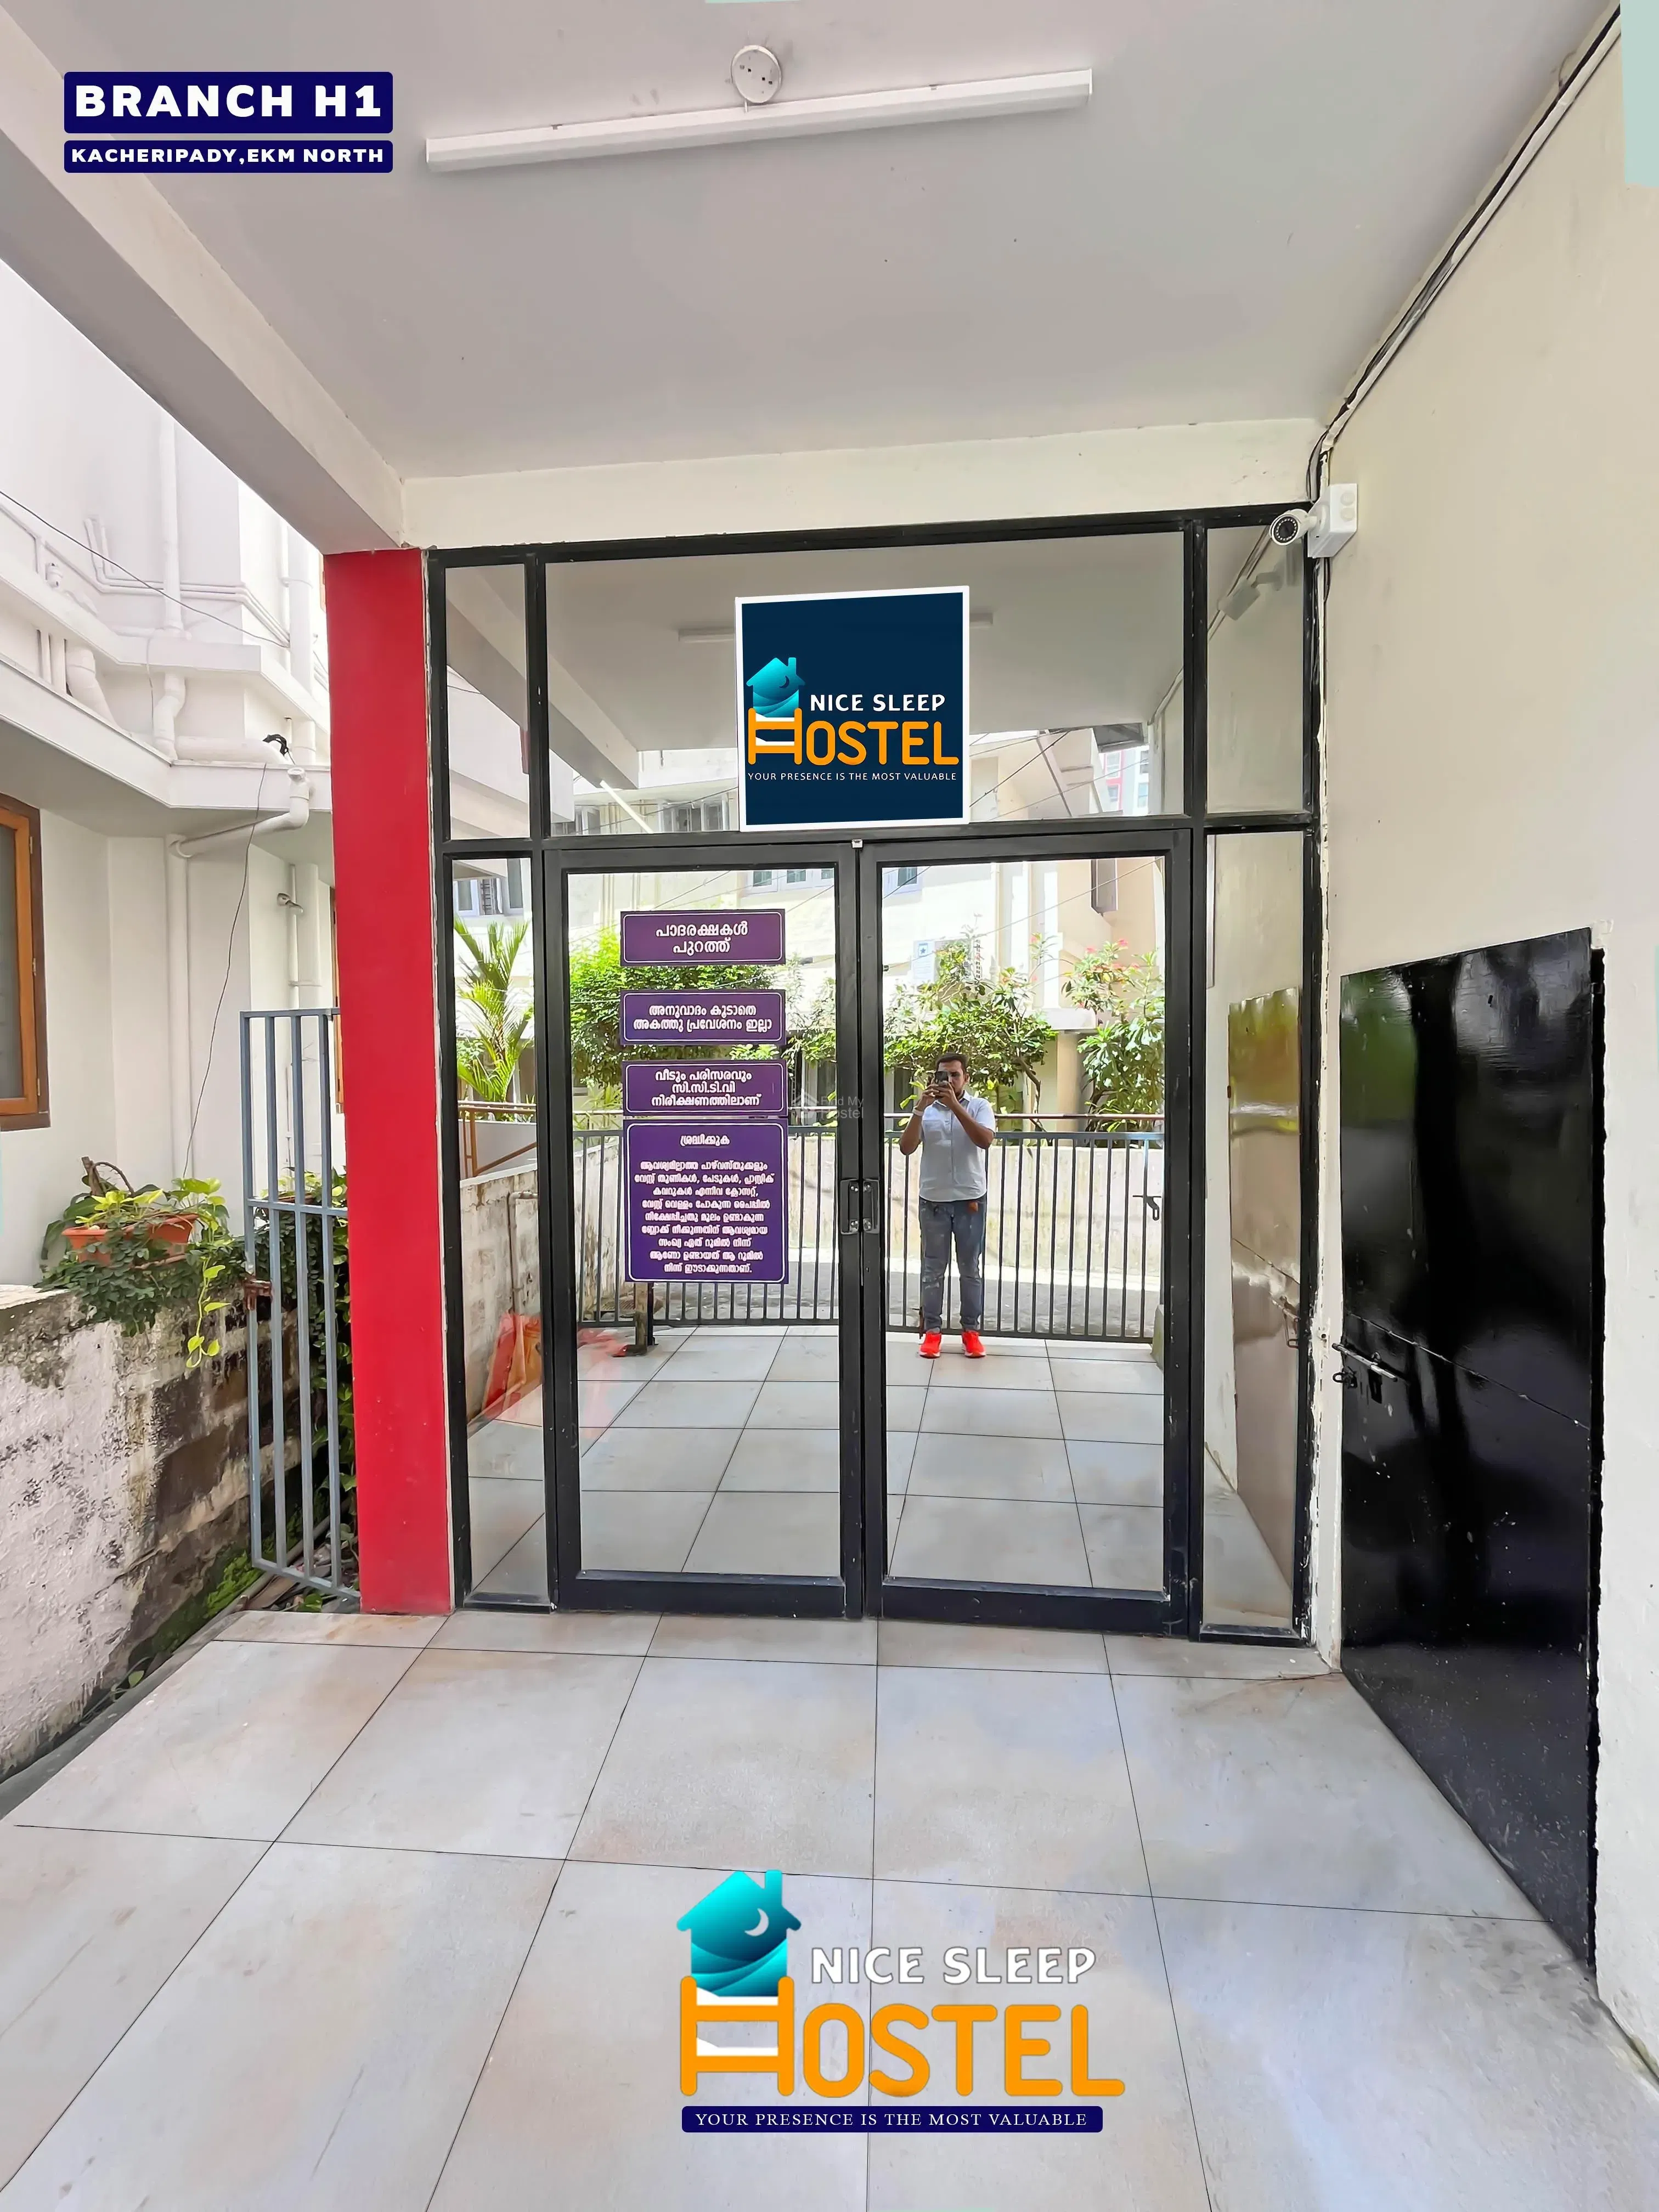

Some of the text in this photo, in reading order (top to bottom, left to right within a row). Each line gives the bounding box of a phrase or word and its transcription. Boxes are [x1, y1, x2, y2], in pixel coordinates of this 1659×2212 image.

[810, 694, 945, 712] NICE SLEEP
[748, 708, 958, 765] HOSTEL
[781, 772, 832, 781] PRESENCE
[836, 772, 845, 781] IS
[656, 920, 748, 936] പാദരക്ഷകൾ
[673, 936, 731, 956] പുറത്ത്
[649, 1005, 707, 1019] അനുവാദം
[633, 1019, 684, 1032] അകത്തു
[686, 1019, 742, 1032] പ്രവേശനം
[655, 1068, 752, 1084] വീടും പരിസരവും
[680, 1133, 730, 1147] ശ്രദ്ധിക്കുക
[695, 1186, 723, 1197] എന്നിവ
[665, 1200, 693, 1210] വെള്ളം
[722, 1251, 736, 1261] ആ
